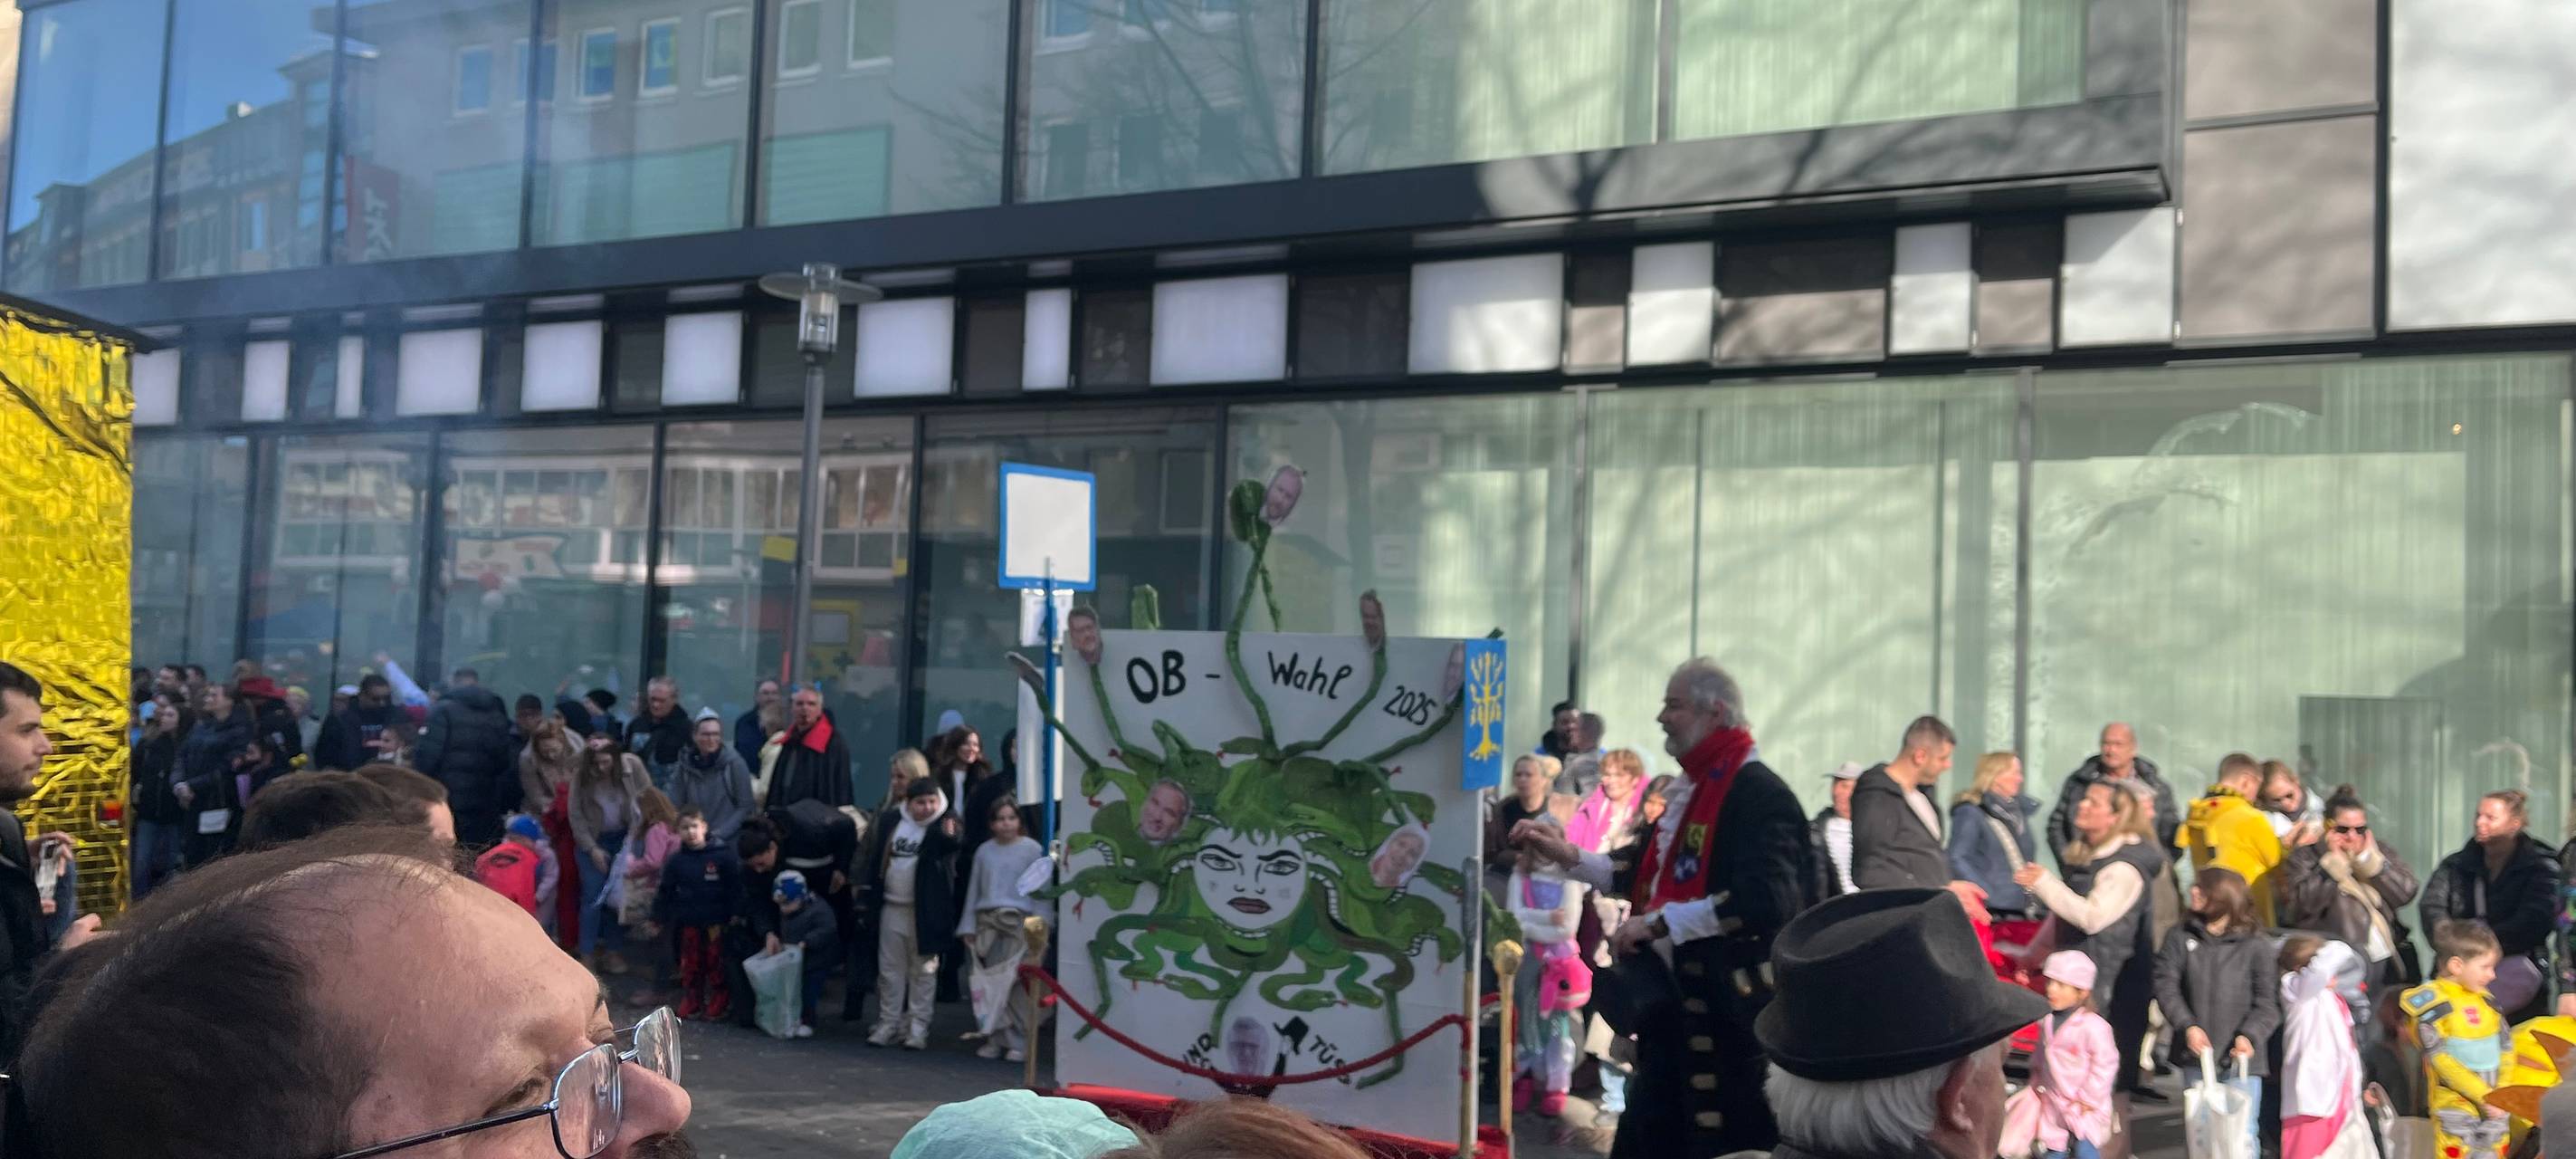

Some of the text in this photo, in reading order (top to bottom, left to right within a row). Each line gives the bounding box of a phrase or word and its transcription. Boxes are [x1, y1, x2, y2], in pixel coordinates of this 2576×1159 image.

[1126, 649, 1187, 704] OB
[1267, 650, 1353, 700] Wahl
[1382, 685, 1439, 726] 2025
[1181, 1032, 1212, 1066] ND
